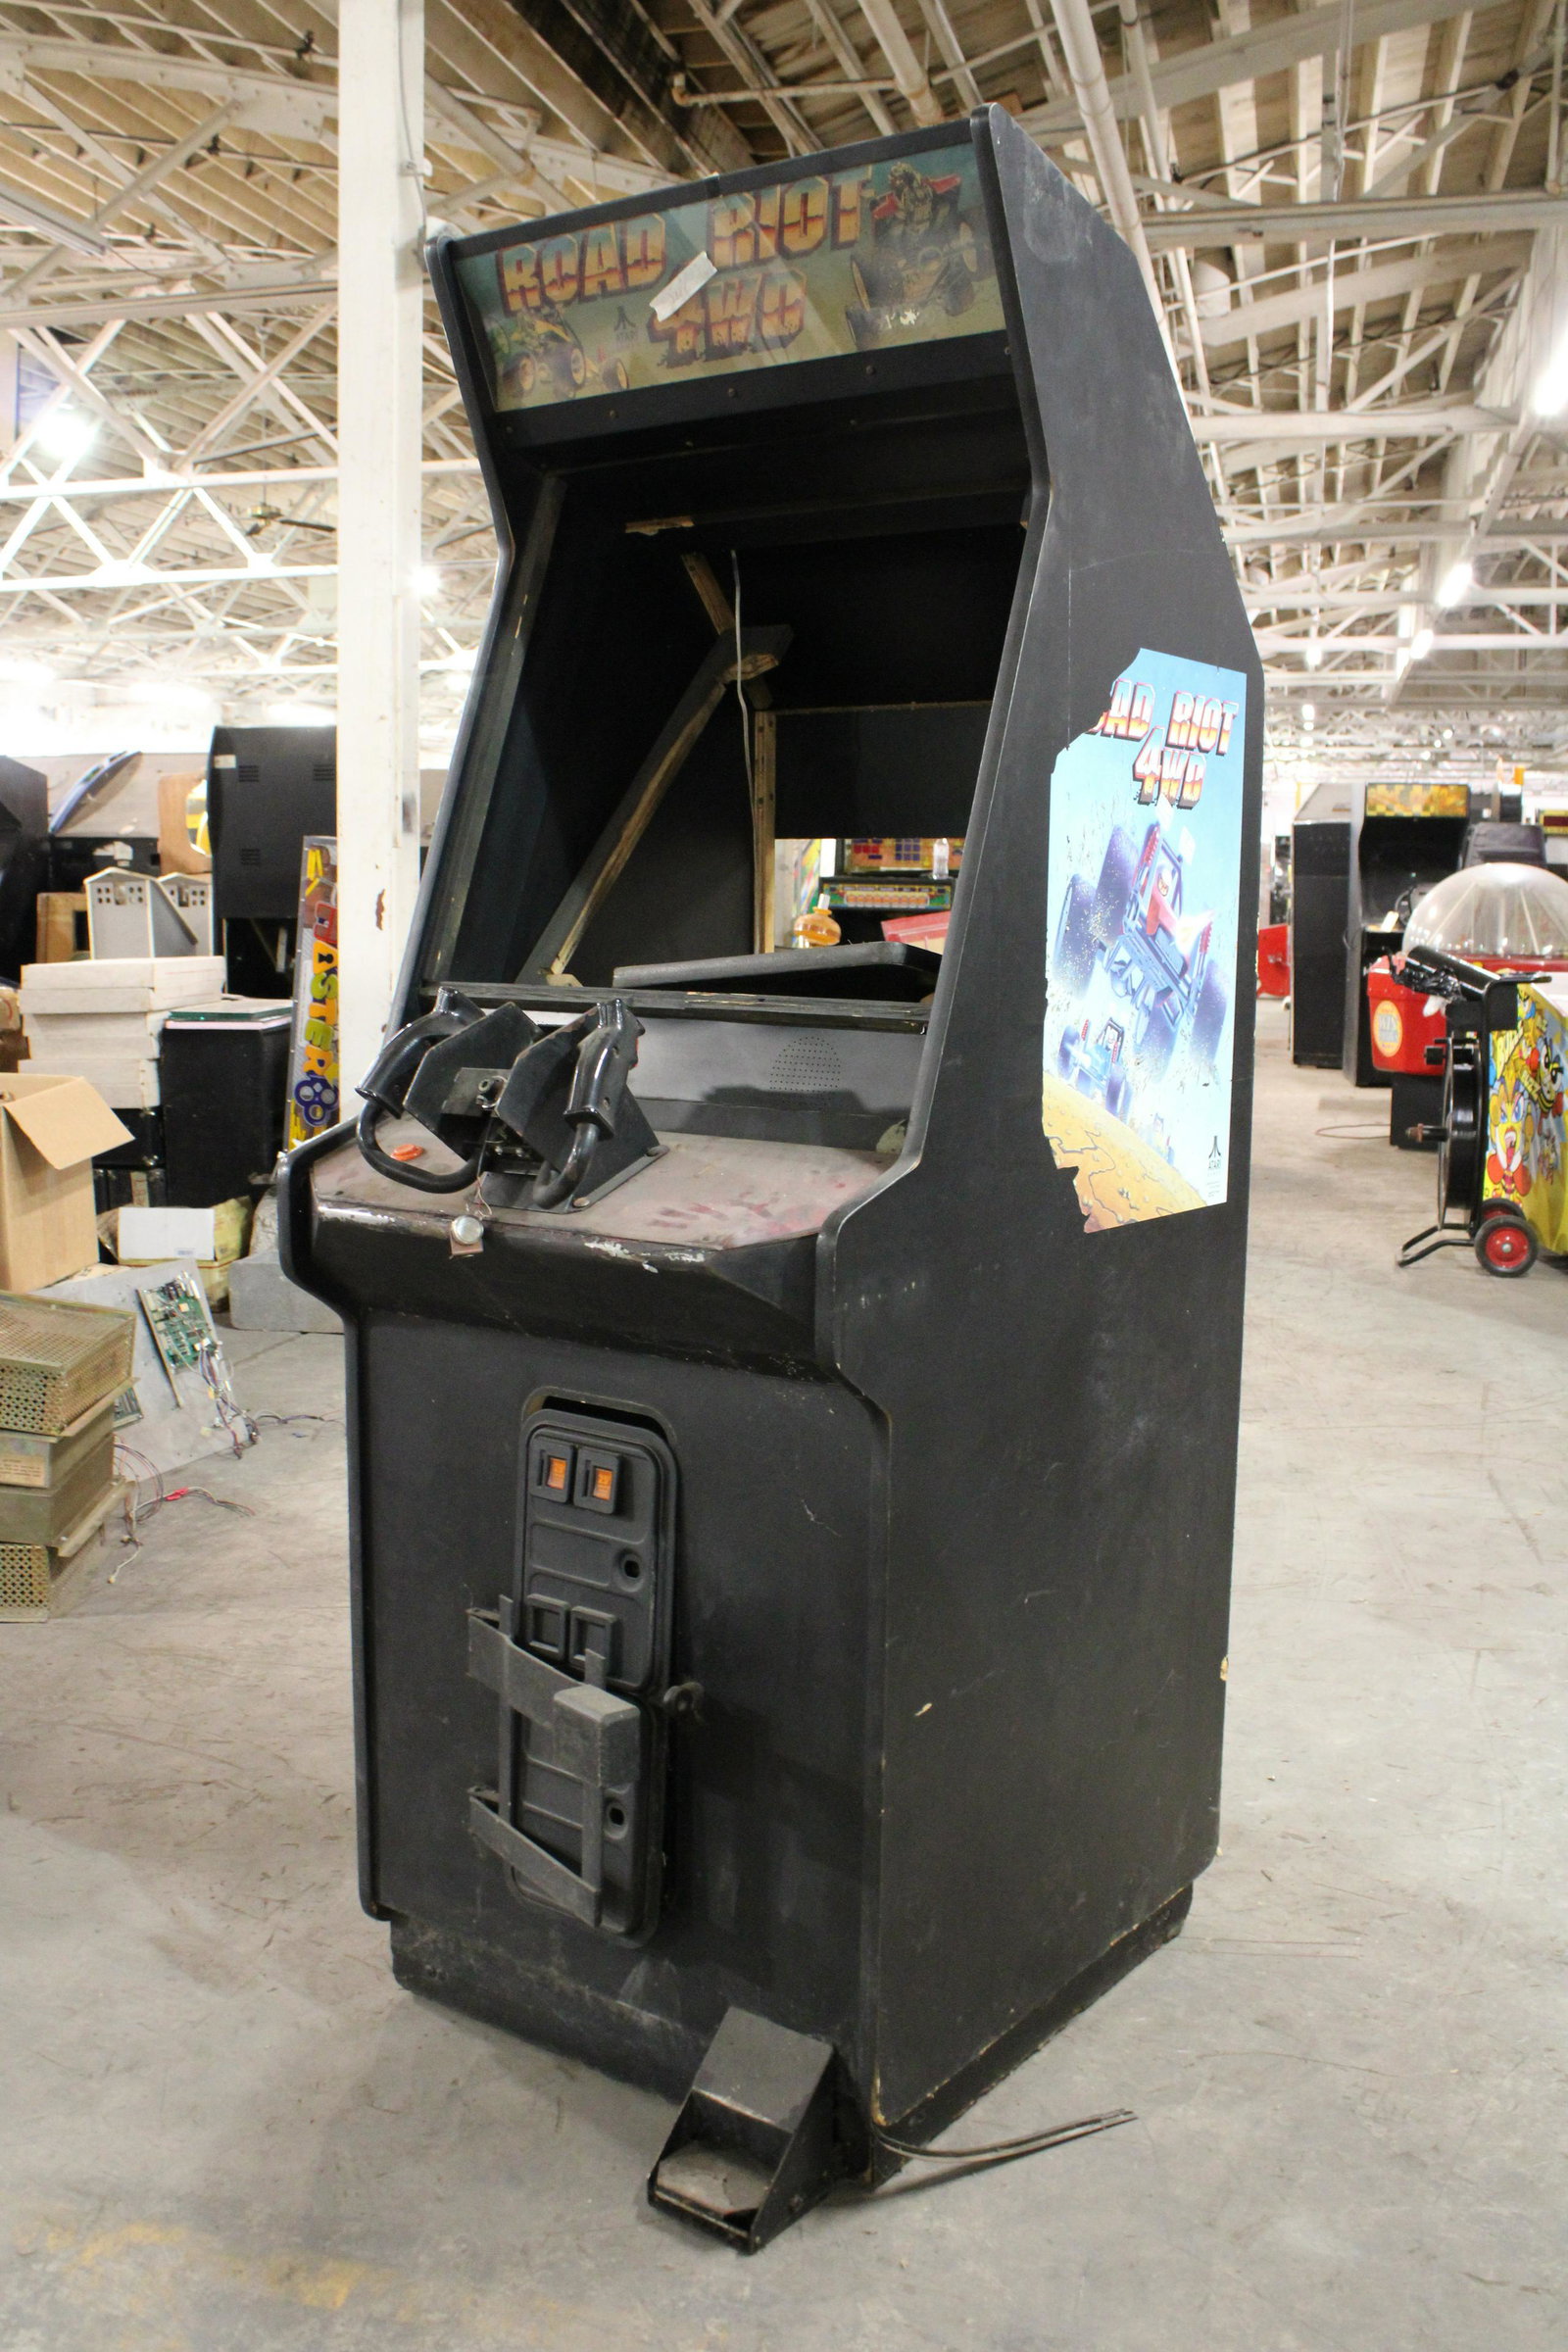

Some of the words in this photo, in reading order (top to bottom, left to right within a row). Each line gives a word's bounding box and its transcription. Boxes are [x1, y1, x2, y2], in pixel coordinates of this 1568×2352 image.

[497, 213, 668, 315] ROAD
[707, 165, 872, 272] RIOT
[1165, 690, 1240, 757] RIOT
[1133, 725, 1207, 810] 4WD
